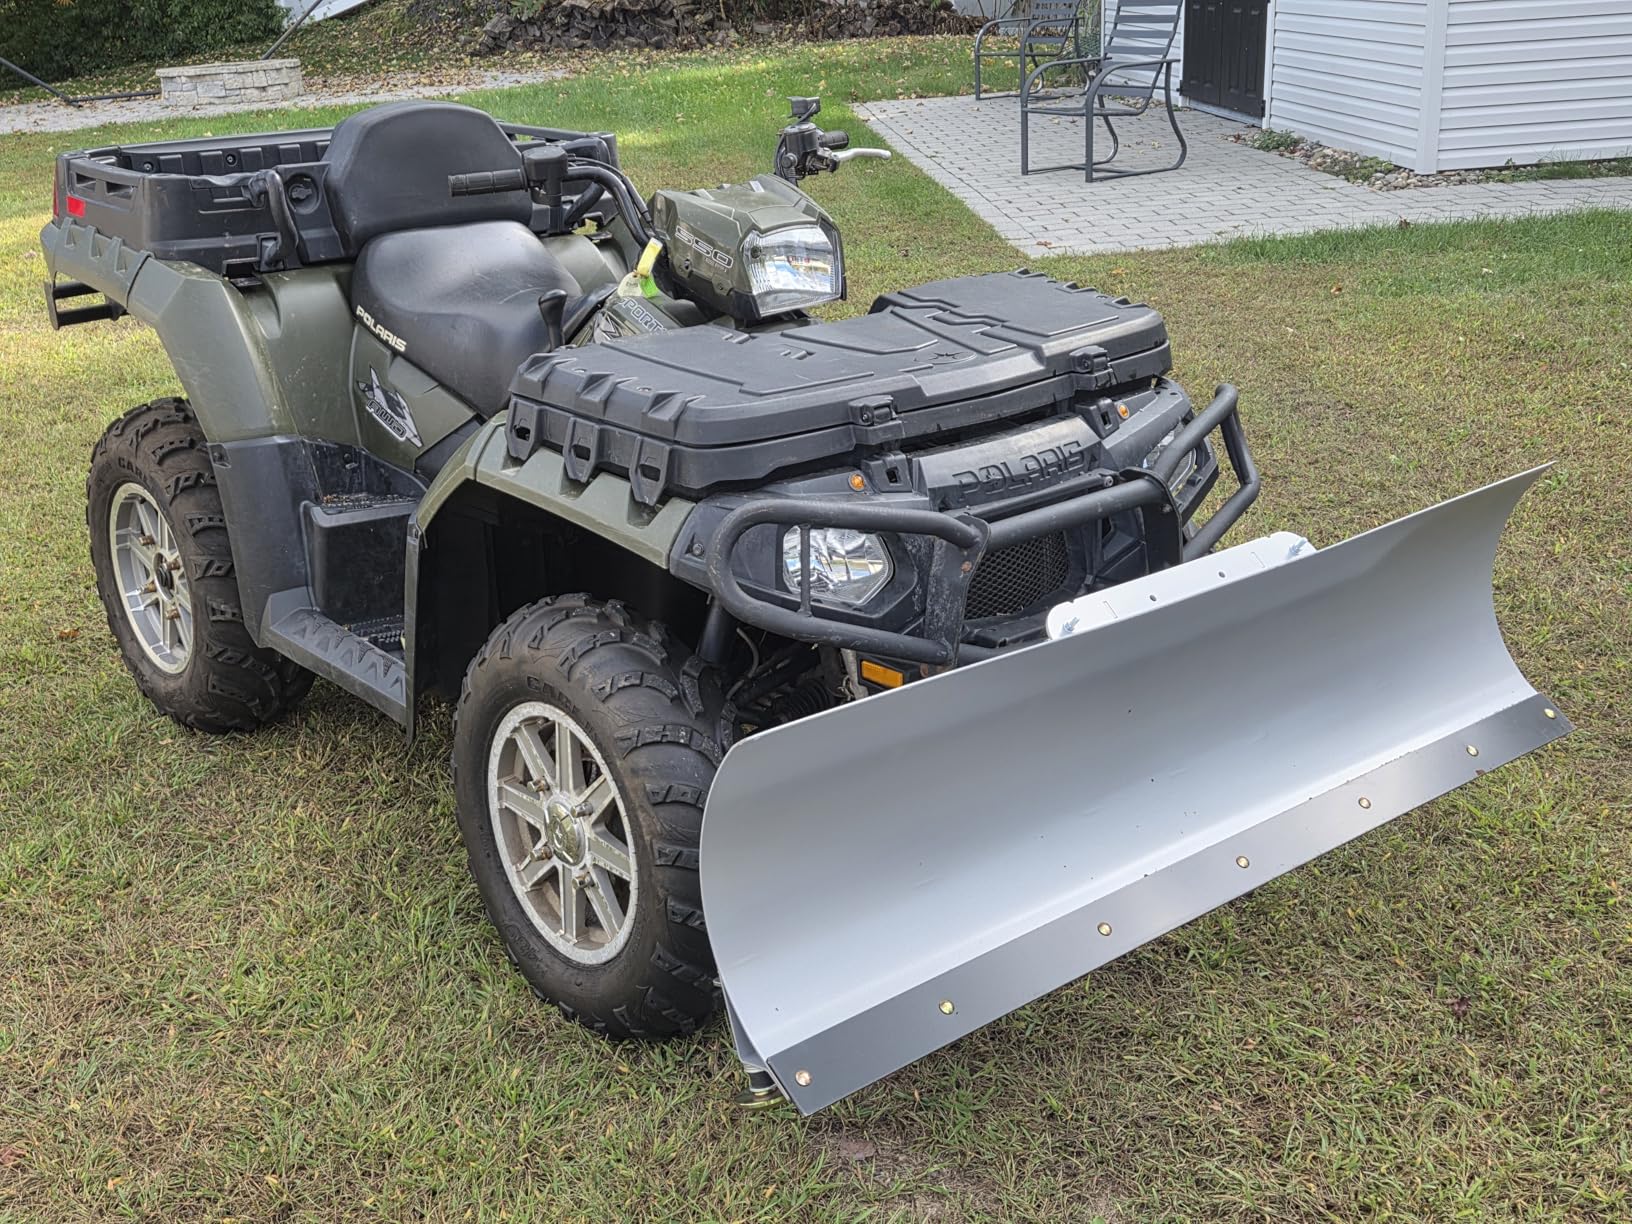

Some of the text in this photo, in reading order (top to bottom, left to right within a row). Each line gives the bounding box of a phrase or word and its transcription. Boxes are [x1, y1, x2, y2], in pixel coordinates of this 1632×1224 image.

[675, 225, 734, 268] 550
[355, 305, 407, 352] POLARIS
[366, 399, 407, 440] AWD
[952, 440, 1086, 500] POLARIS
